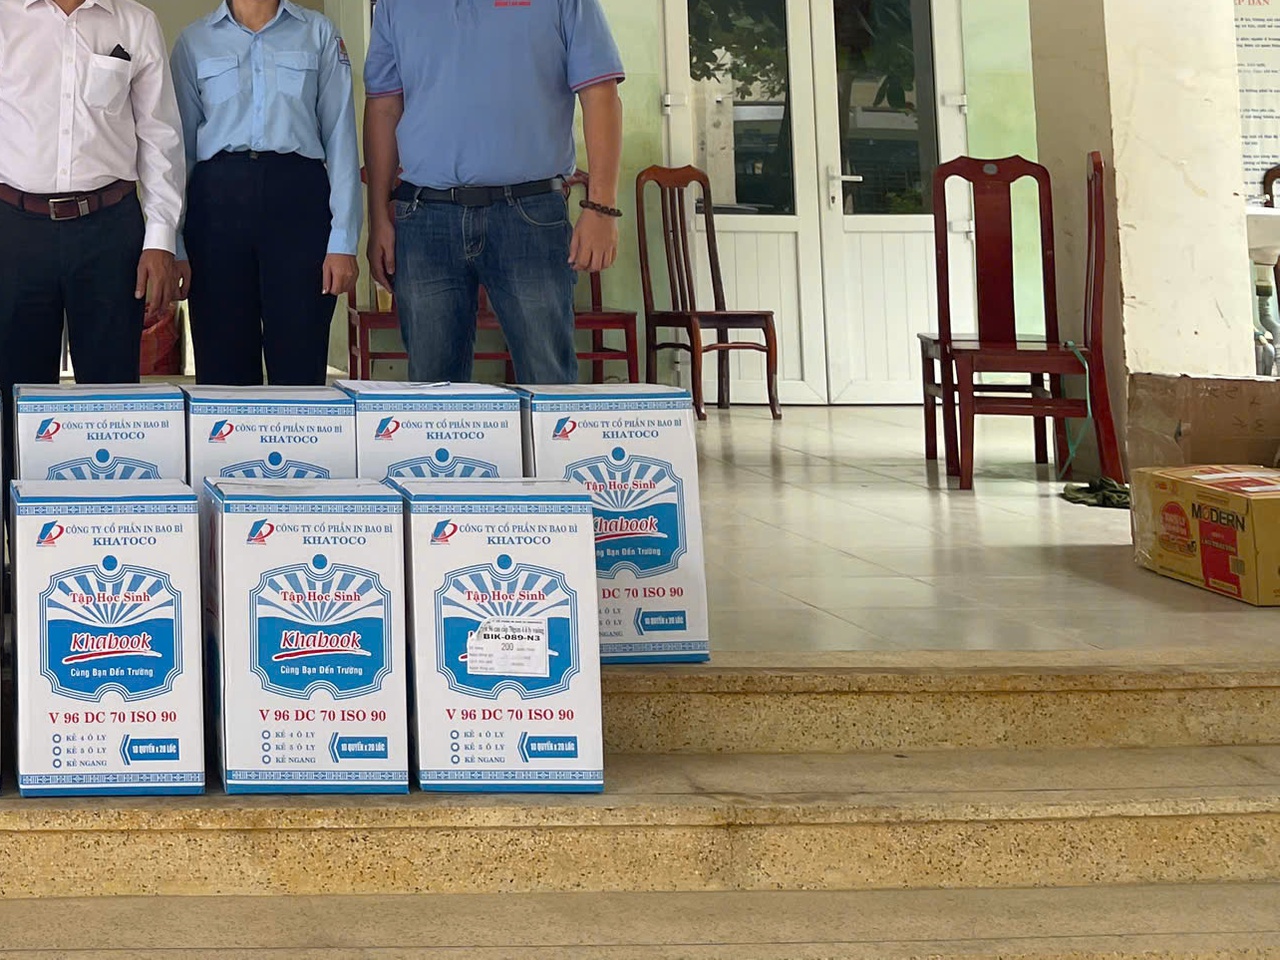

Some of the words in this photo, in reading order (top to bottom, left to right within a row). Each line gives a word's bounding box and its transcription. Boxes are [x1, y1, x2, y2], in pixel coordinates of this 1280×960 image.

[401, 421, 422, 429] CÔNG
[87, 431, 145, 440] KHATOCO
[260, 435, 318, 444] KHATOCO
[426, 432, 484, 440] KHATOCO
[602, 430, 659, 439] KHATOCO
[585, 481, 605, 491] Tập
[608, 481, 629, 492] Học
[632, 480, 656, 489] Sinh
[1191, 503, 1245, 531] MODERN
[459, 524, 482, 533] CÔNG
[538, 525, 546, 533] IN
[549, 525, 566, 533] BAO
[93, 537, 156, 546] KHATOCO
[303, 536, 366, 545] KHATOCO
[487, 536, 551, 545] KHATOCO
[71, 593, 93, 604] Tập
[98, 593, 120, 605] Học
[124, 592, 150, 602] Sinh
[281, 591, 303, 602] Tập
[307, 591, 330, 603] Học
[334, 592, 360, 602] Sinh
[465, 591, 488, 602] Tập
[493, 591, 516, 603] Học
[519, 591, 546, 601] Sinh
[71, 632, 152, 651] Khabook
[281, 630, 361, 649] Khabook
[483, 633, 541, 641] BIK-089-N3
[71, 668, 89, 678] Cùng
[93, 668, 107, 678] Bạn
[109, 667, 125, 676] Đến
[128, 668, 153, 677] Trường
[280, 665, 299, 676] Cùng
[302, 666, 317, 676] Bạn
[319, 665, 334, 674] Đến
[337, 666, 363, 676] Trường
[49, 713, 60, 724] V
[64, 713, 80, 724] 96
[84, 712, 106, 724] DC
[110, 712, 126, 723] 70
[131, 711, 157, 723] ISO
[161, 711, 177, 723] 90
